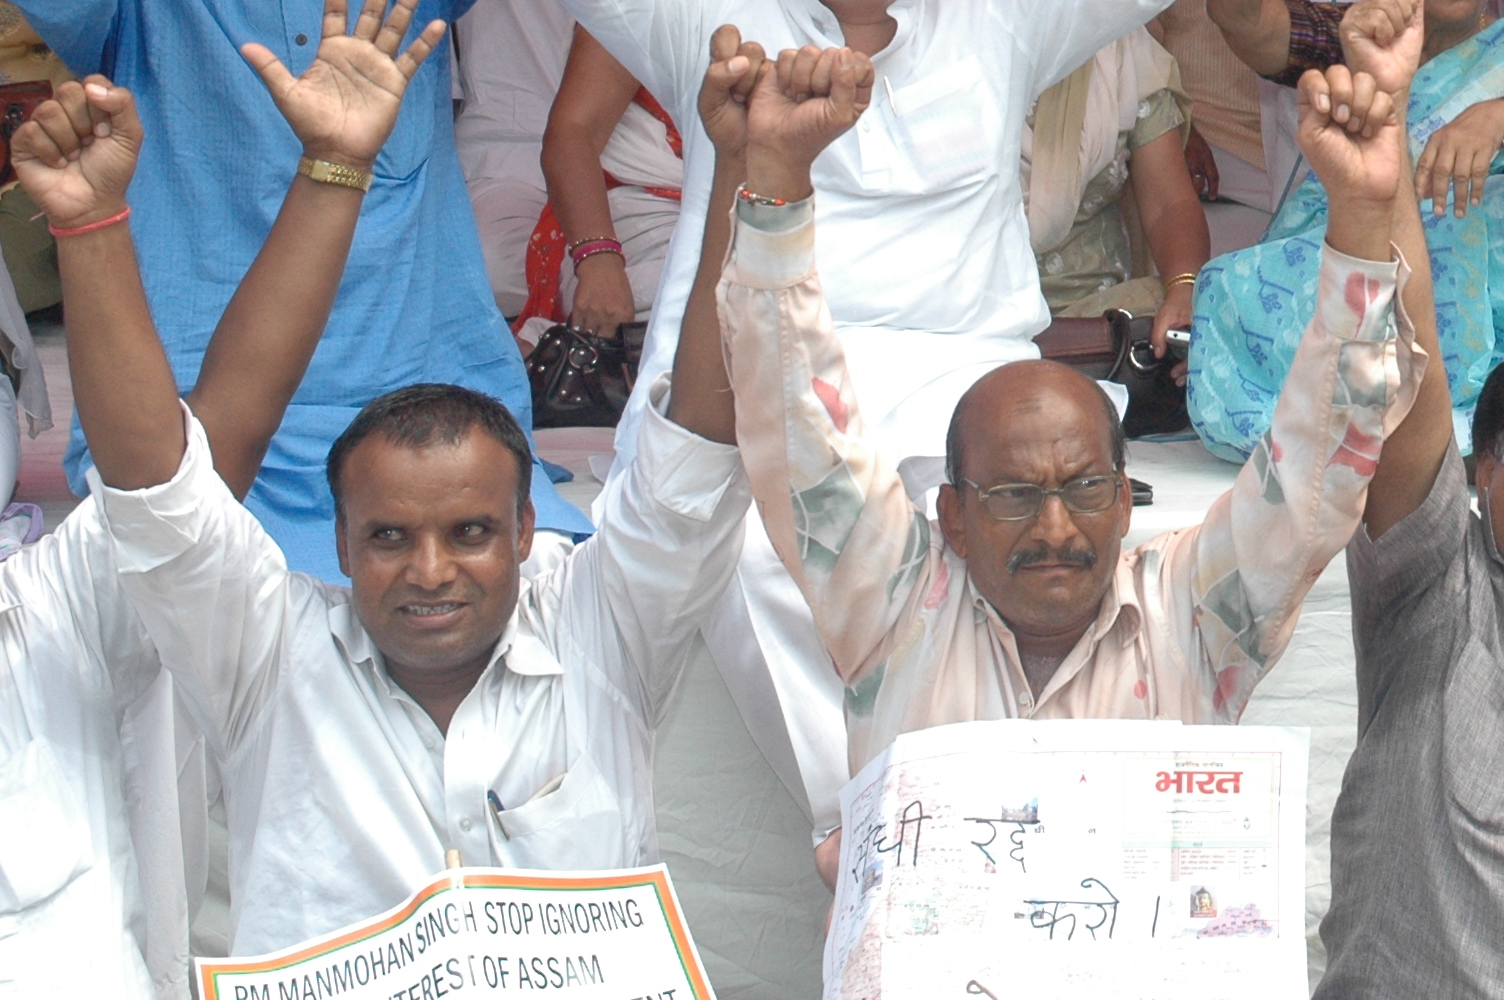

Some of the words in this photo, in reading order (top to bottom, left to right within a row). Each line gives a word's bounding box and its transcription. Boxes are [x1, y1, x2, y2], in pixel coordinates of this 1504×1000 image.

[1155, 771, 1243, 794] भारत
[1023, 878, 1120, 940] करो
[278, 932, 415, 1000] MANMOHAN
[415, 901, 477, 955] SINGH
[484, 901, 534, 935] STOP
[538, 898, 644, 935] IGNORING
[482, 955, 510, 989] OF
[518, 954, 605, 990] ASSAM
